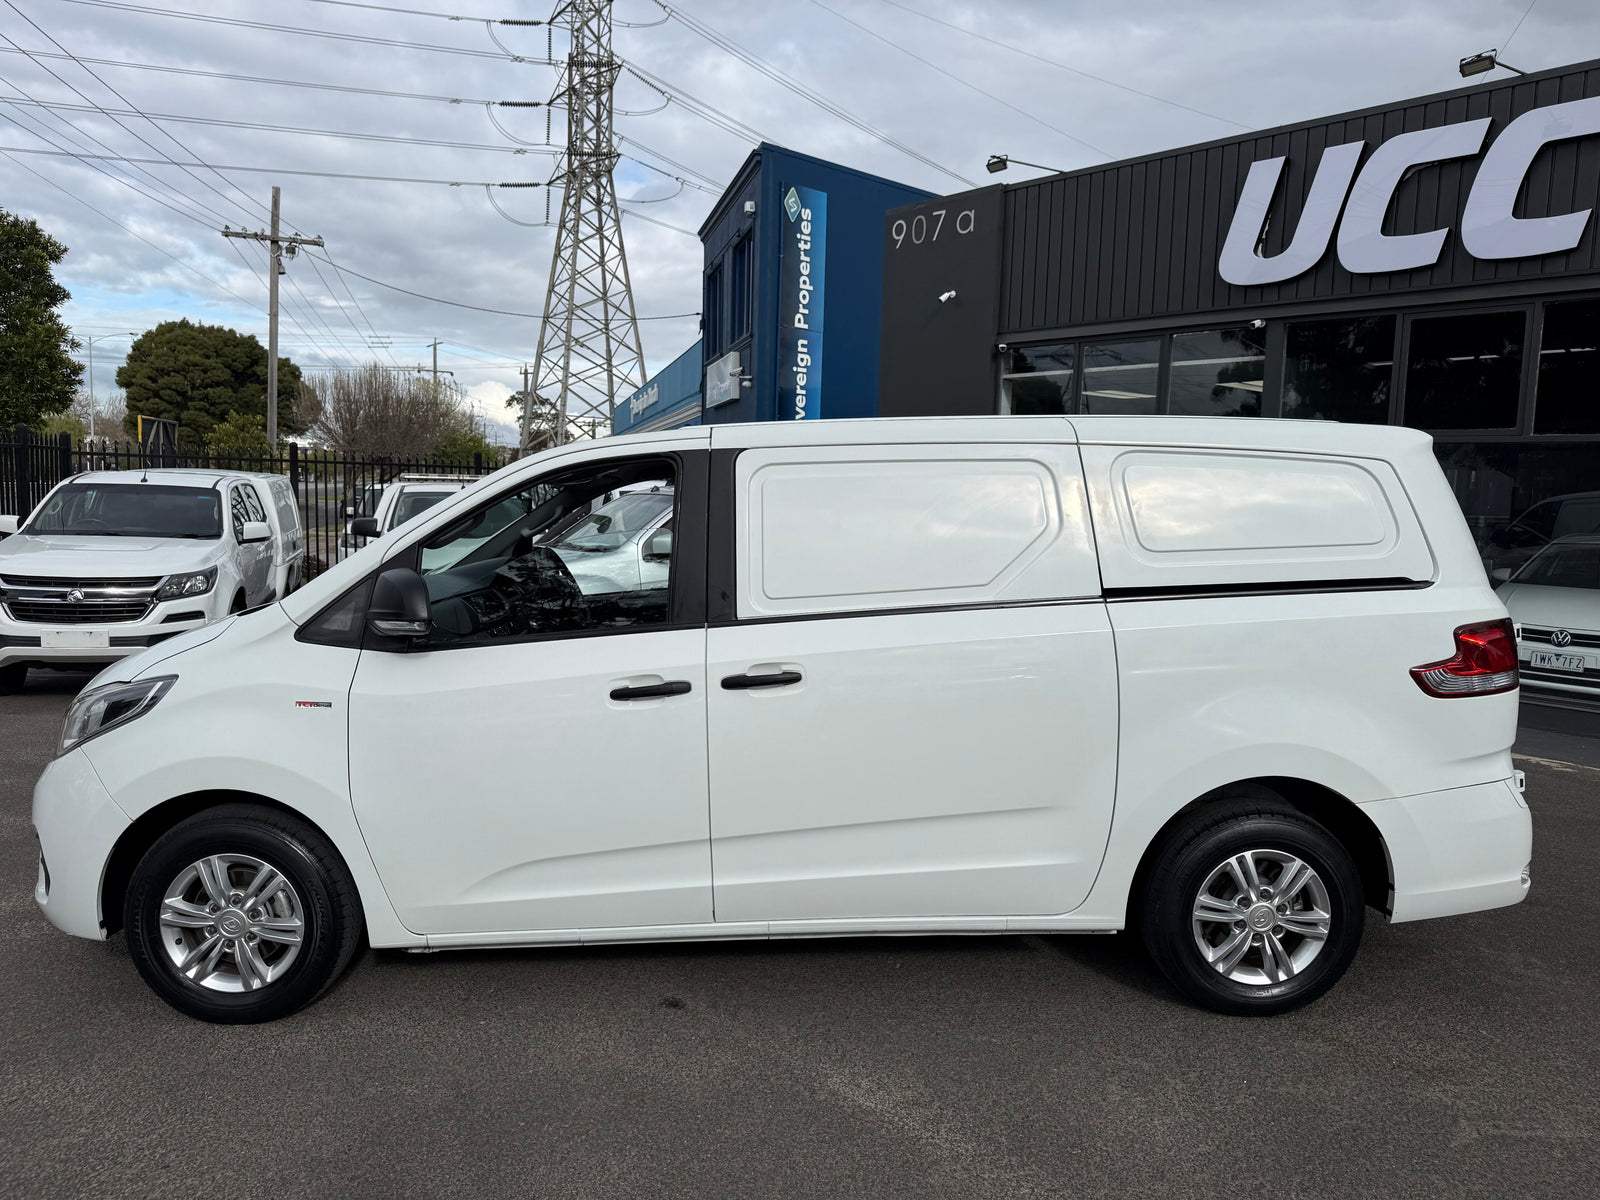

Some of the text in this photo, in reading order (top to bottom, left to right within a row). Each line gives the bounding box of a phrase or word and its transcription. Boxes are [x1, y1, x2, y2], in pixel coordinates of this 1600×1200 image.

[1218, 95, 1600, 286] UCC
[794, 207, 813, 329] Properties
[1562, 656, 1582, 669] 7FZ
